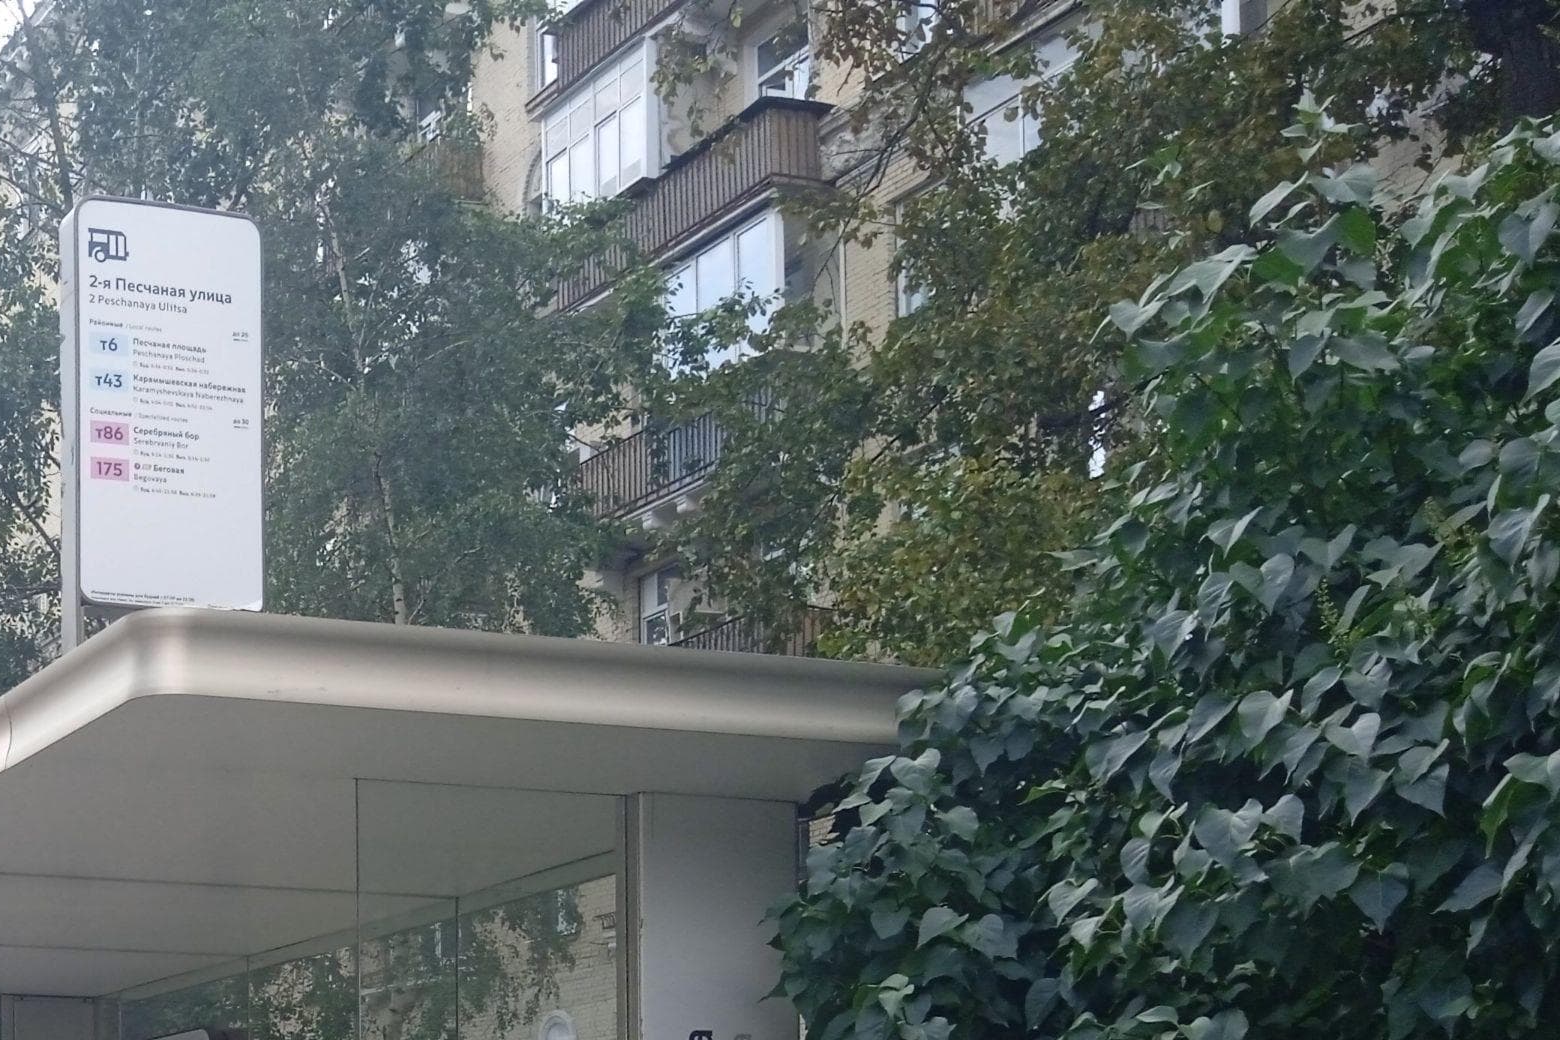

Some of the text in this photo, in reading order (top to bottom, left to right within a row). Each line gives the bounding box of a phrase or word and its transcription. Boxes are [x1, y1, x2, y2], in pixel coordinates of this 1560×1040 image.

[89, 275, 233, 305] 2-я Песчаная улица
[89, 294, 188, 314] 2 Peschanaya Ulitsa
[133, 337, 208, 354] Песчаная площадь
[133, 373, 246, 393] Карамышевская набережная
[133, 426, 183, 439] Серебряный
[96, 461, 123, 477] 175
[153, 464, 185, 475] Беговая
